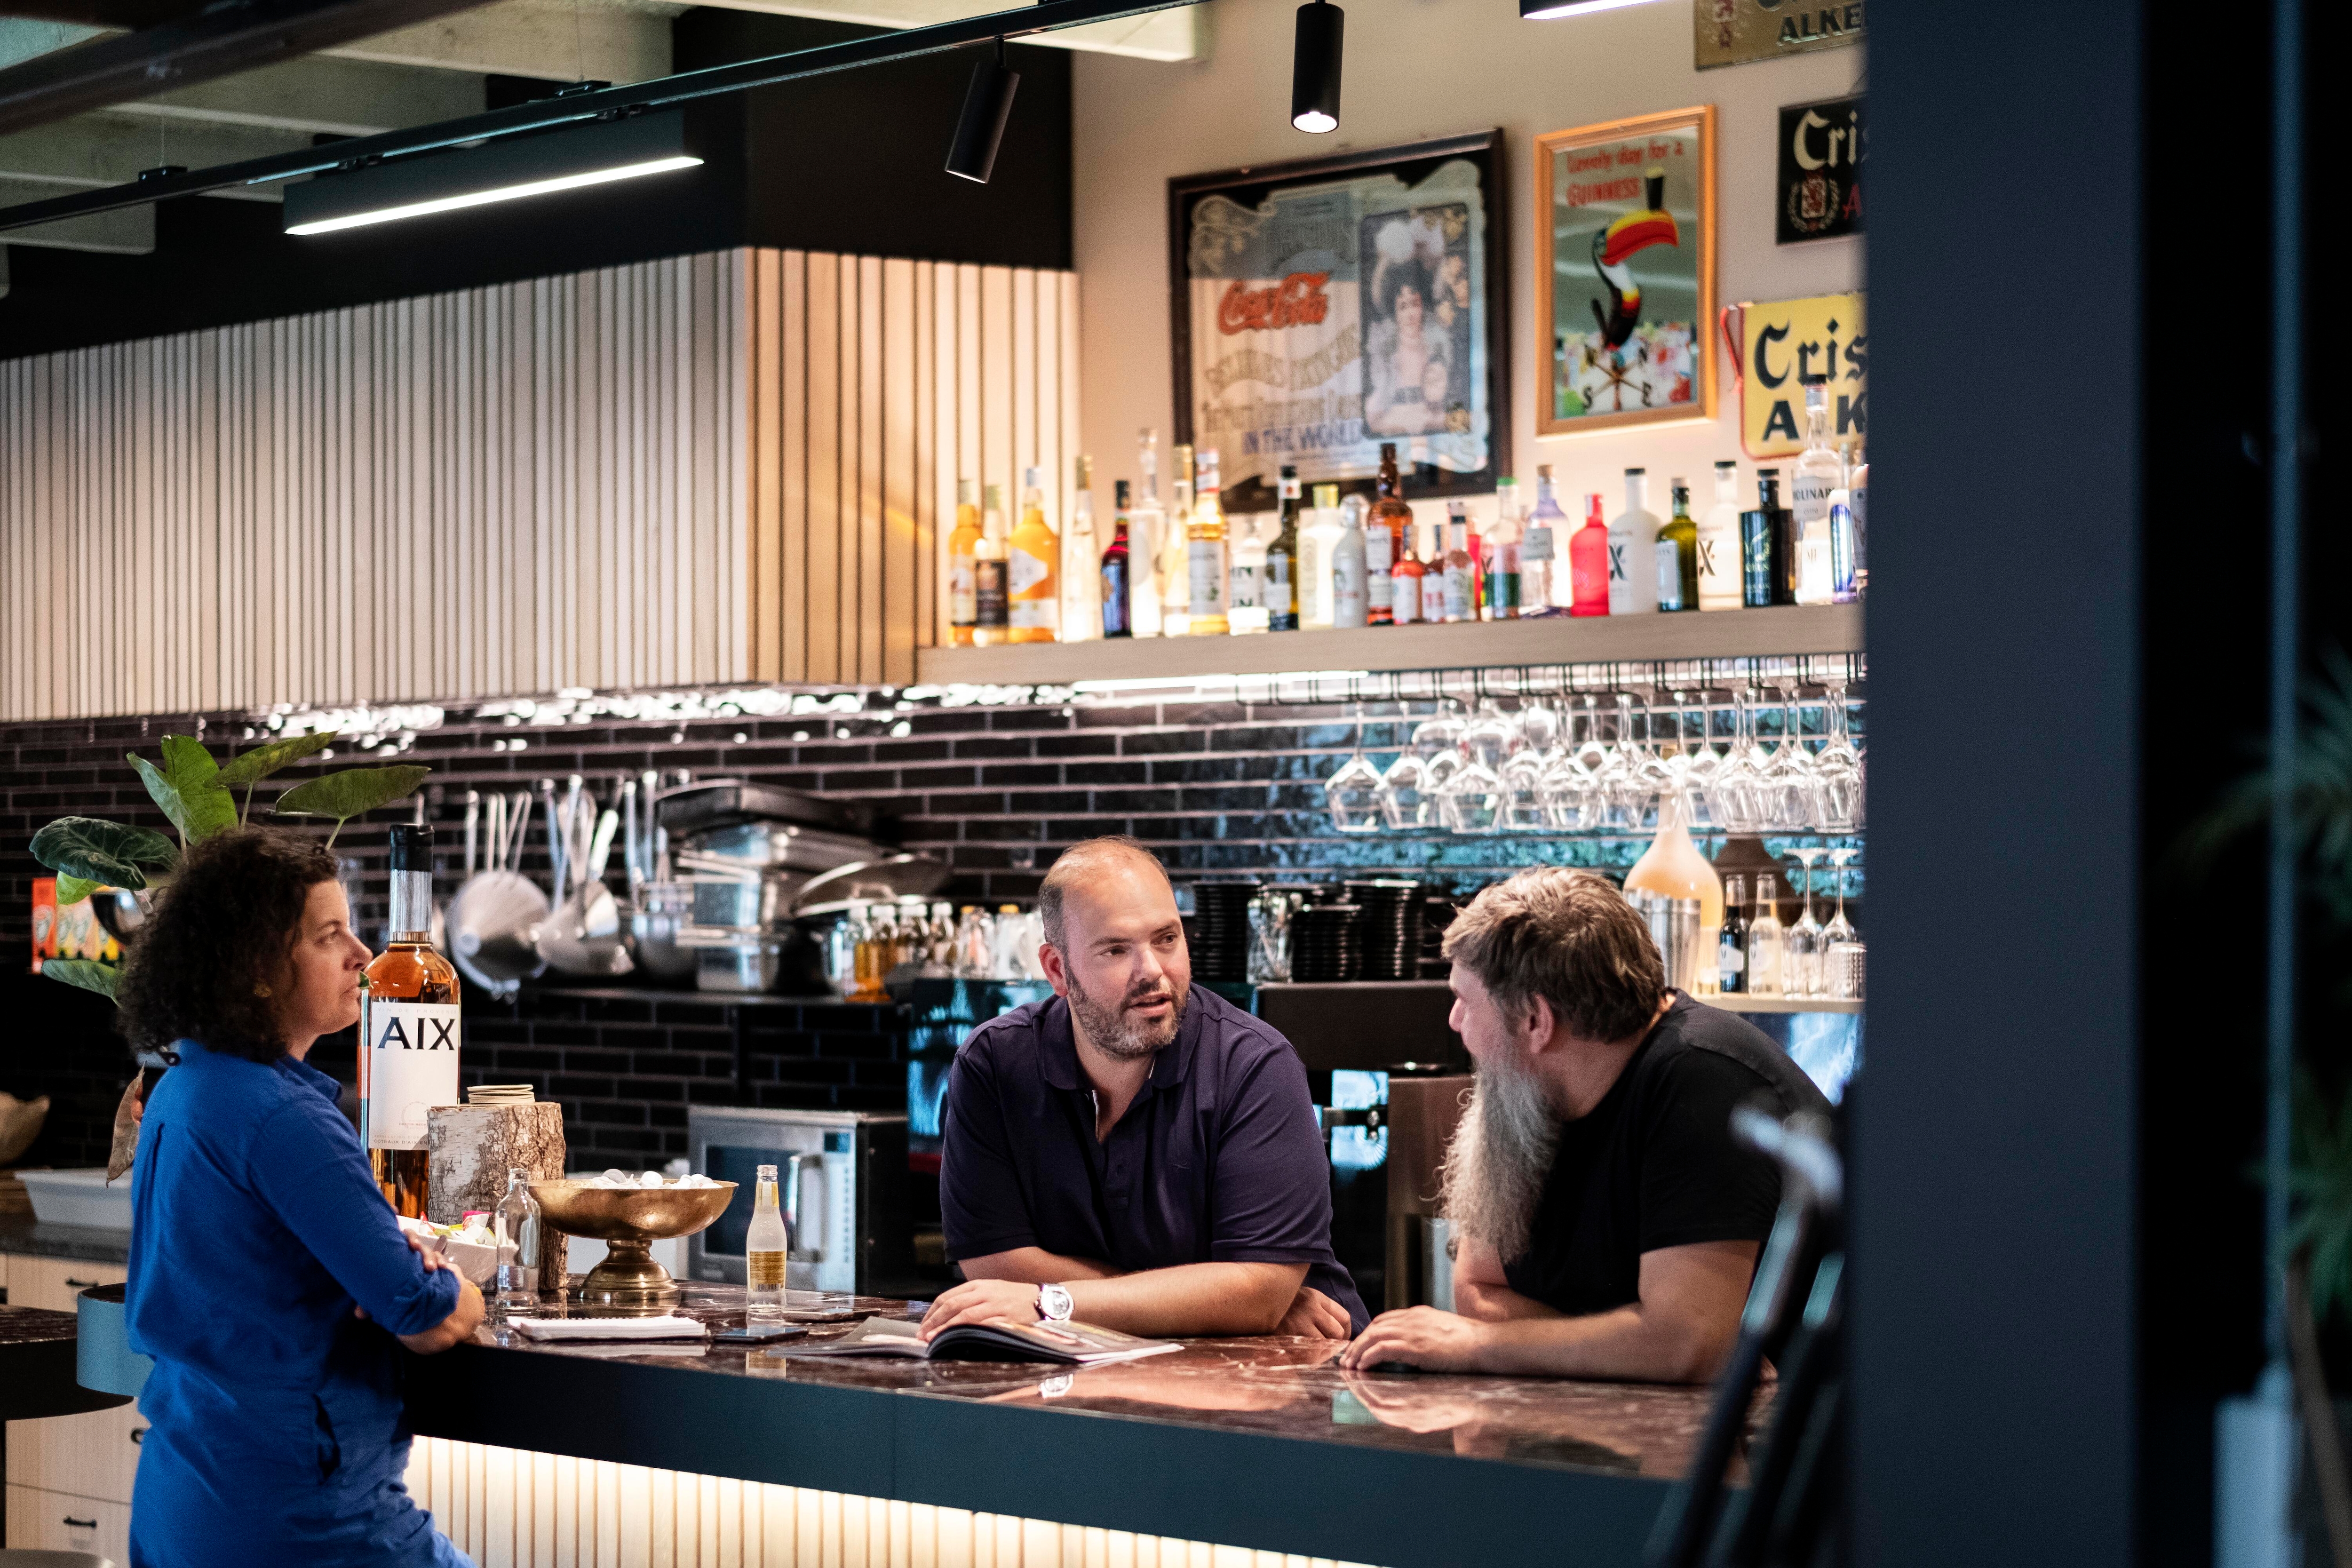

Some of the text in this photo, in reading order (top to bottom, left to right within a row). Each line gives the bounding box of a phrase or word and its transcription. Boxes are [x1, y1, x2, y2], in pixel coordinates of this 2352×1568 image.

[1617, 145, 1643, 166] day
[1648, 140, 1668, 159] for
[1675, 141, 1684, 156] a
[1583, 387, 1594, 409] S
[378, 1017, 456, 1051] AIX
